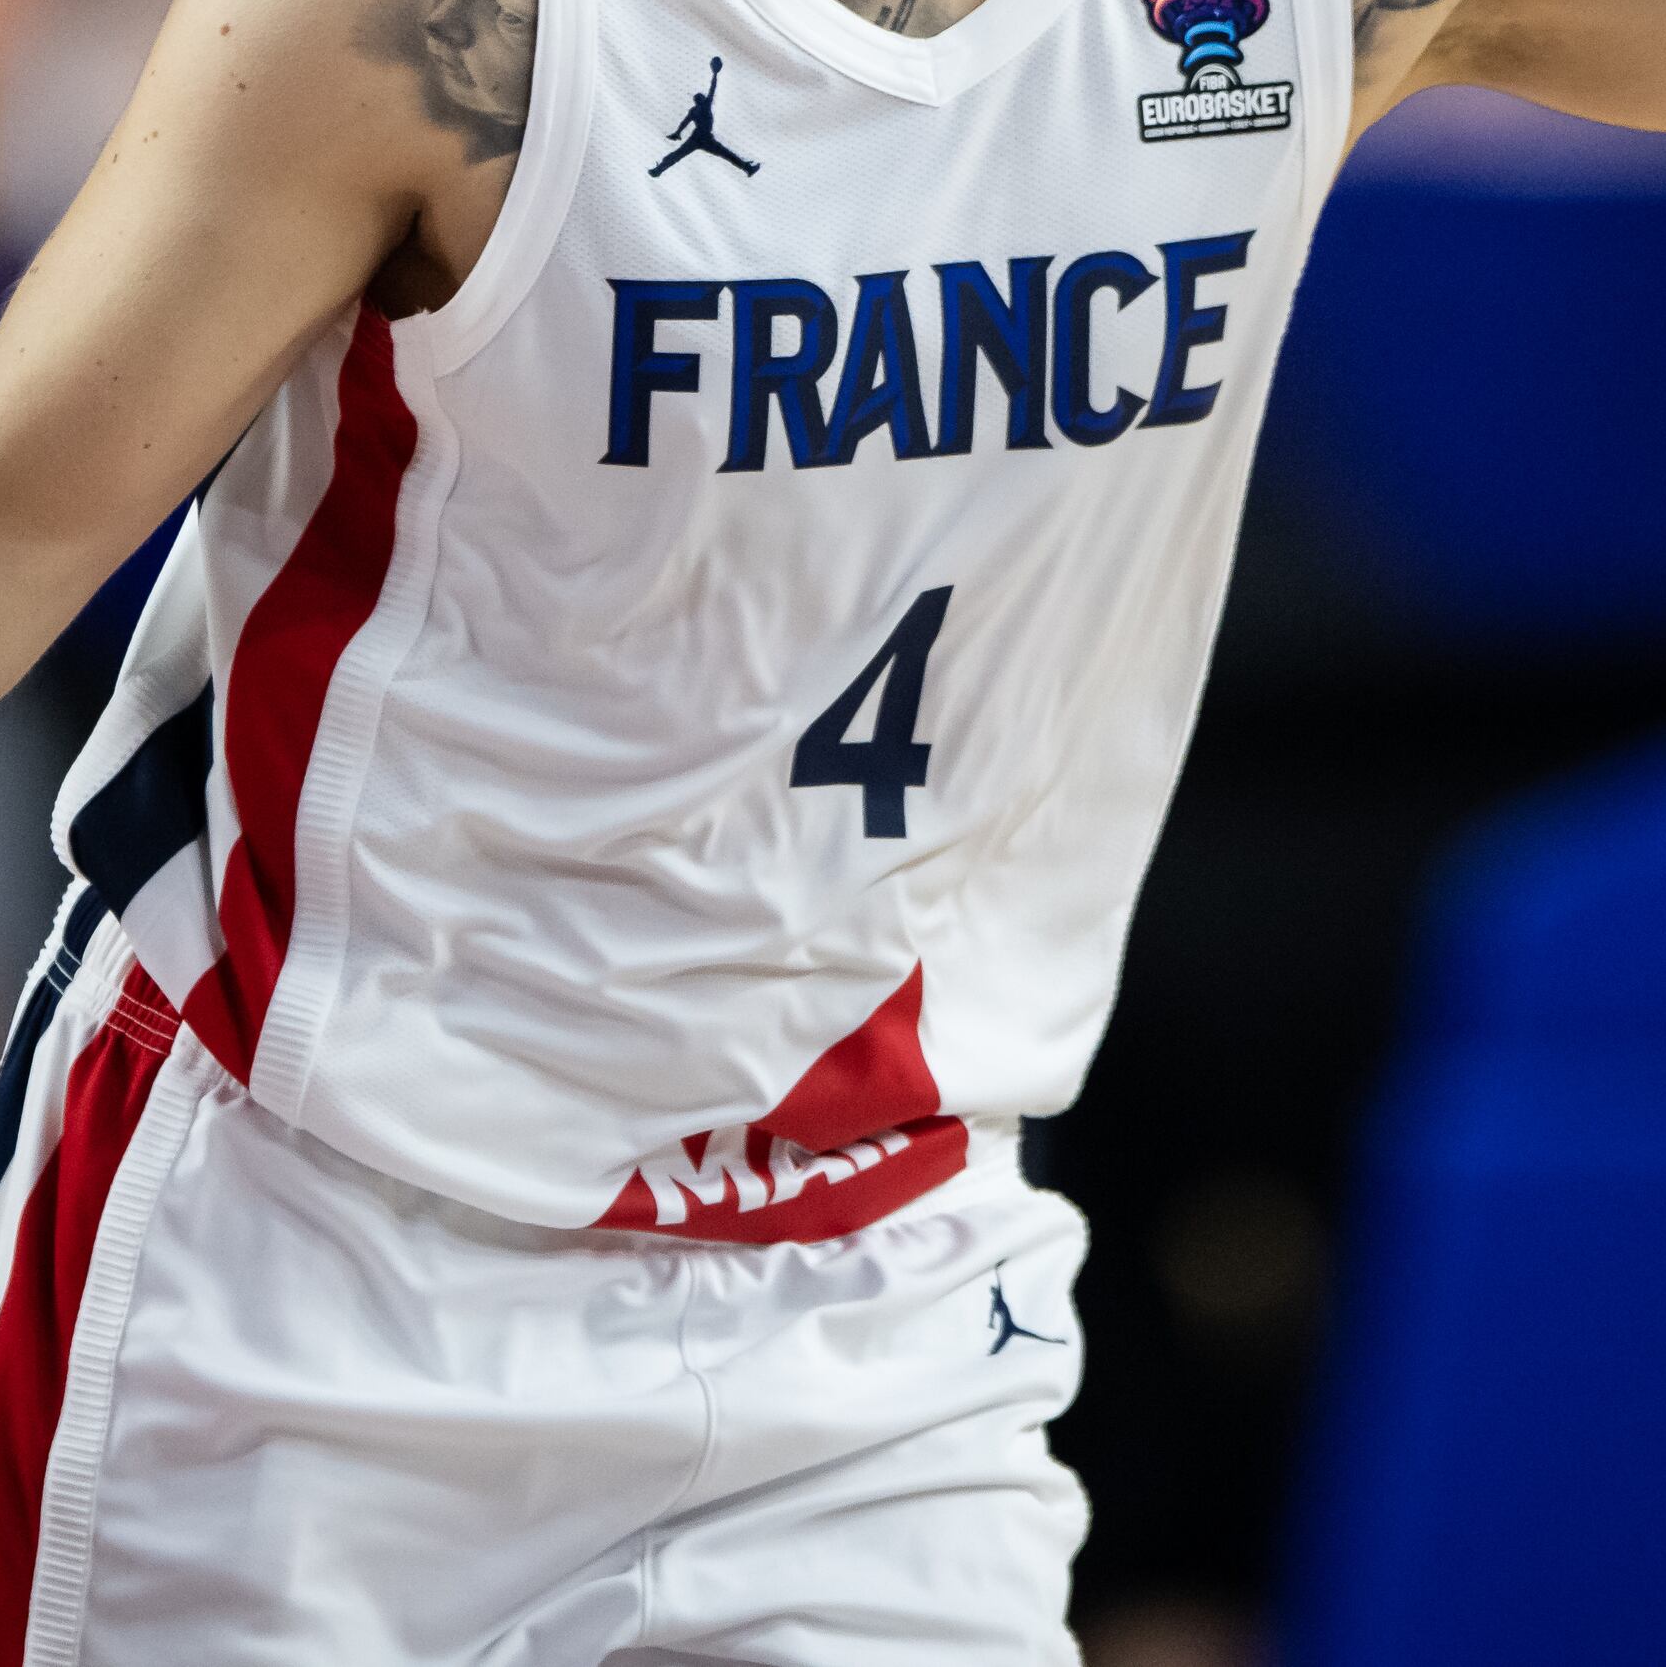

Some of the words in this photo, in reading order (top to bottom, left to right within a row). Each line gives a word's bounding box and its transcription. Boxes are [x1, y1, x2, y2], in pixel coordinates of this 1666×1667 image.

[1142, 85, 1291, 127] EUROBASKET
[1199, 75, 1228, 91] FIBA
[598, 230, 1257, 473] FRANCE
[789, 585, 954, 840] 4
